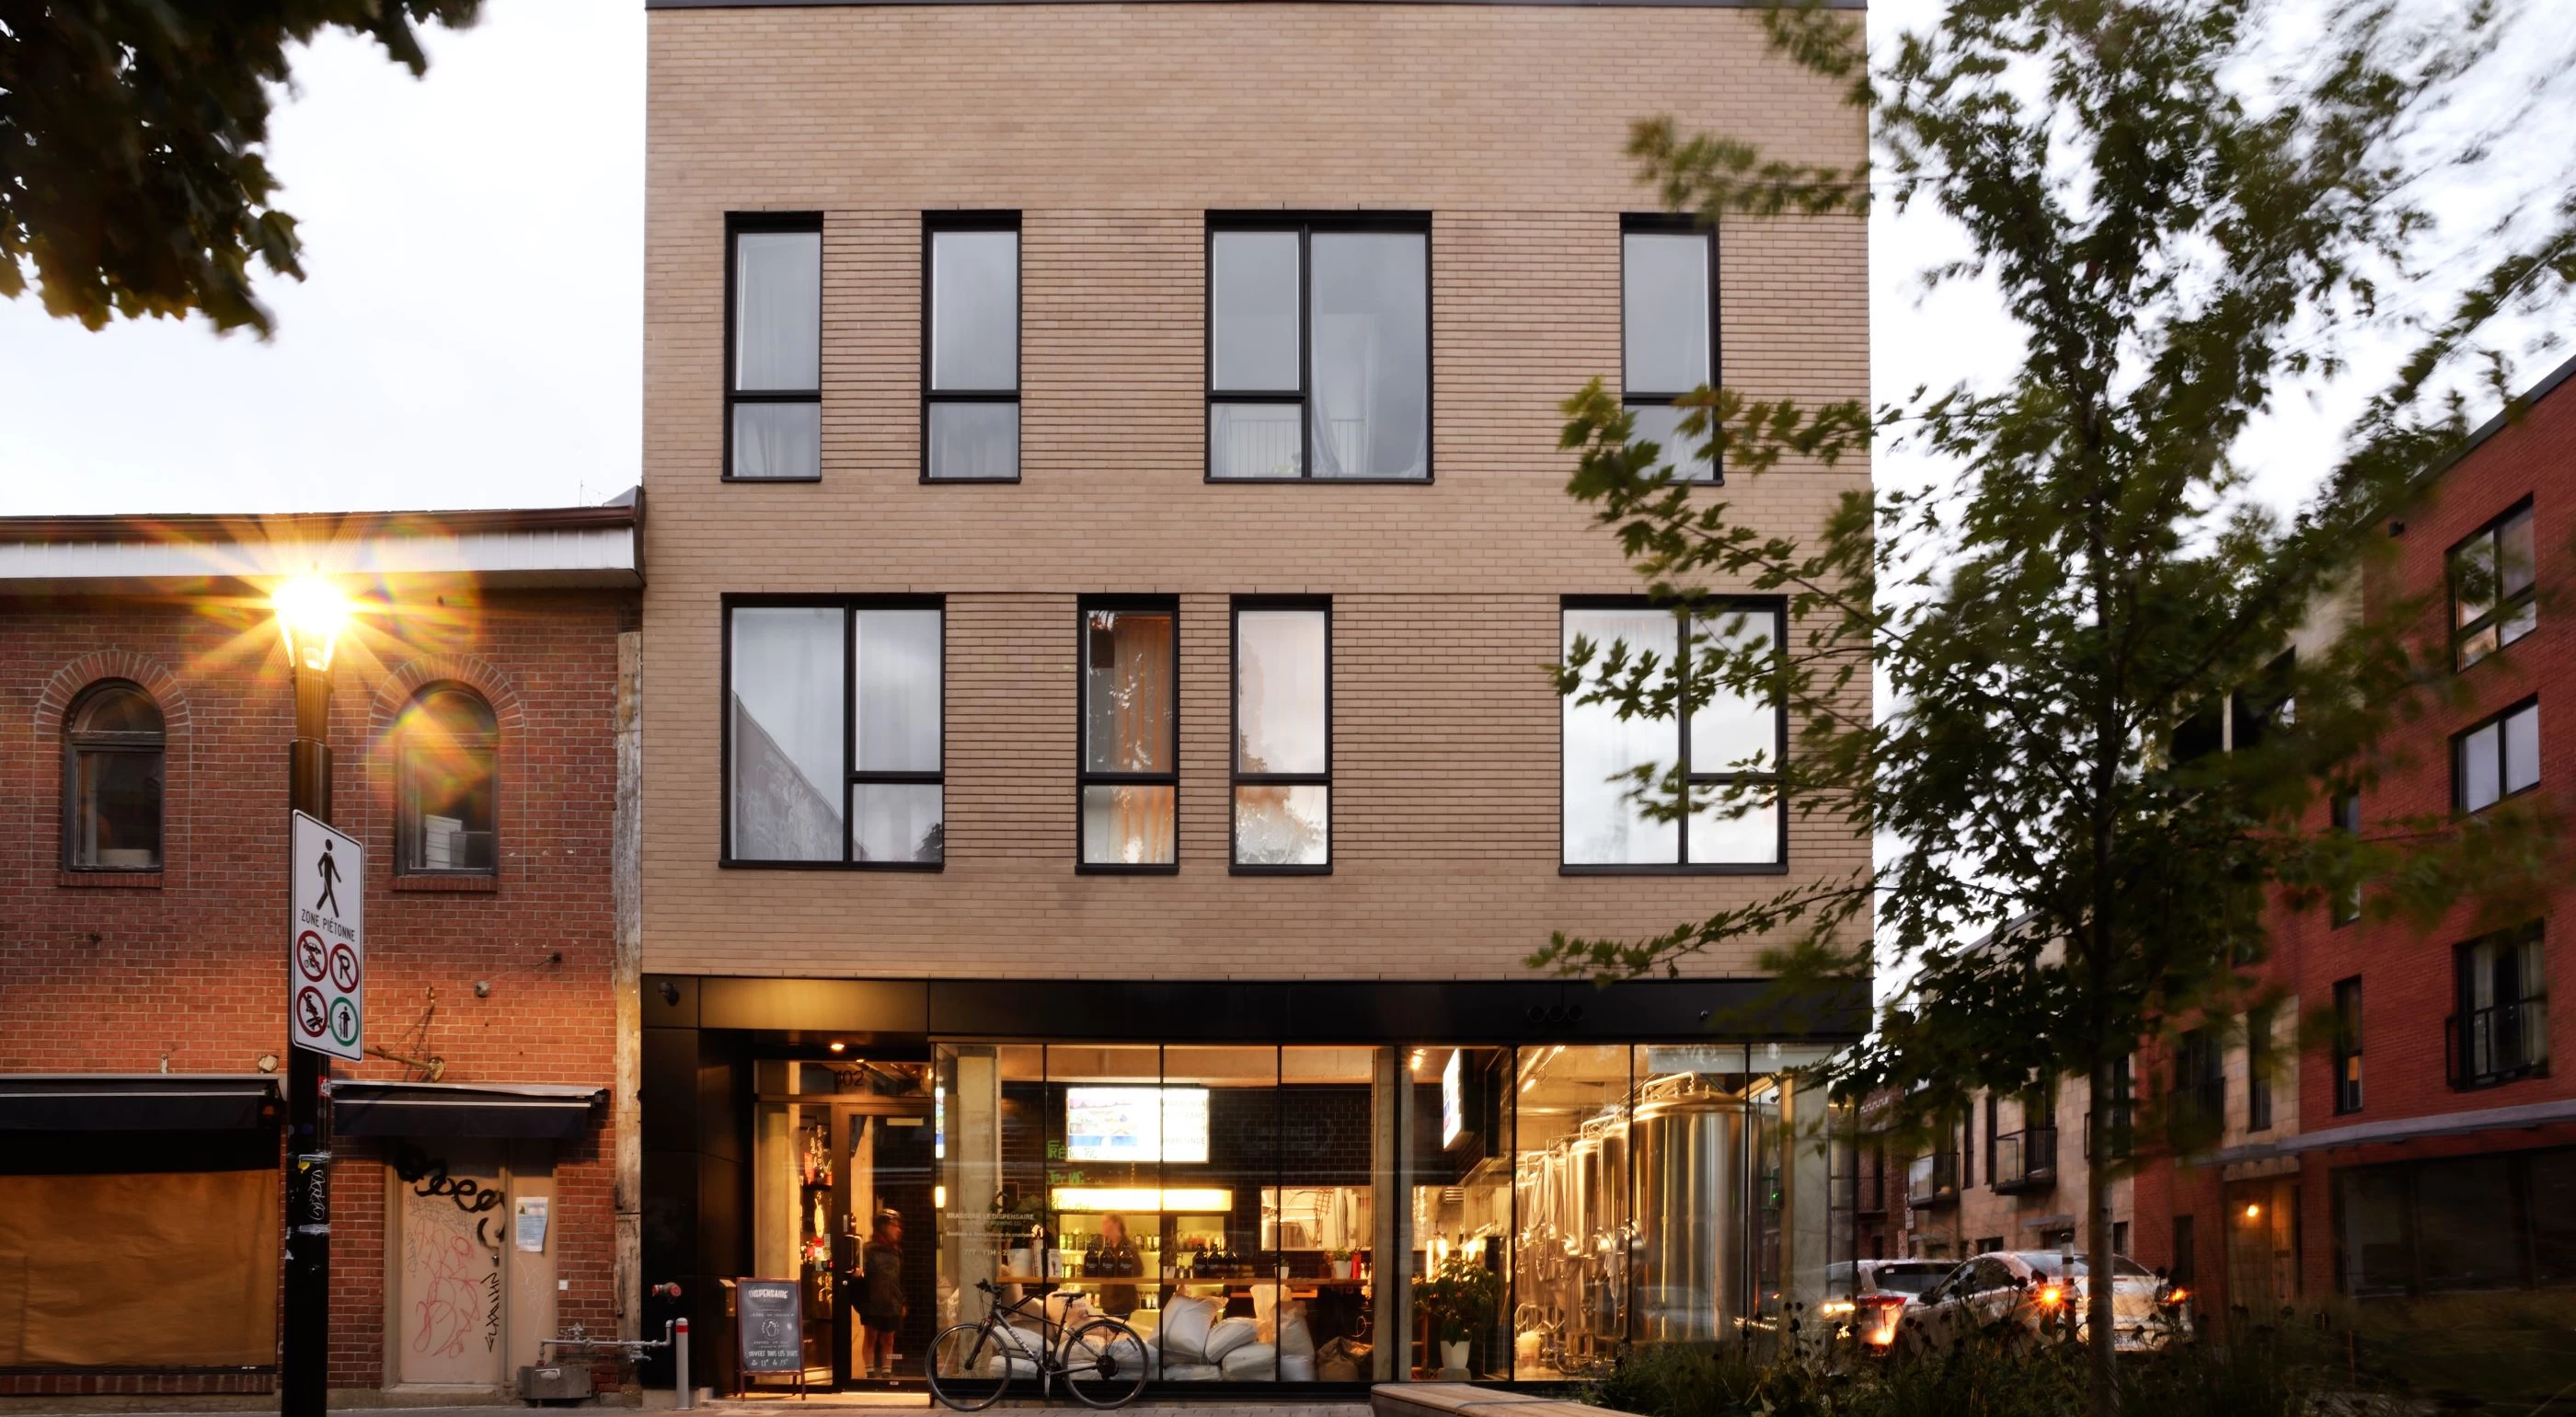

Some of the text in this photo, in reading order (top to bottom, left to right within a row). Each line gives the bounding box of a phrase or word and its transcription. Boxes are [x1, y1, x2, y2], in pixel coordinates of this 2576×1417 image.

[302, 909, 355, 942] ZONE PIÉTONNE
[339, 954, 351, 979] P
[838, 1070, 865, 1086] 102
[748, 1289, 788, 1298] DISPENSAIRE
